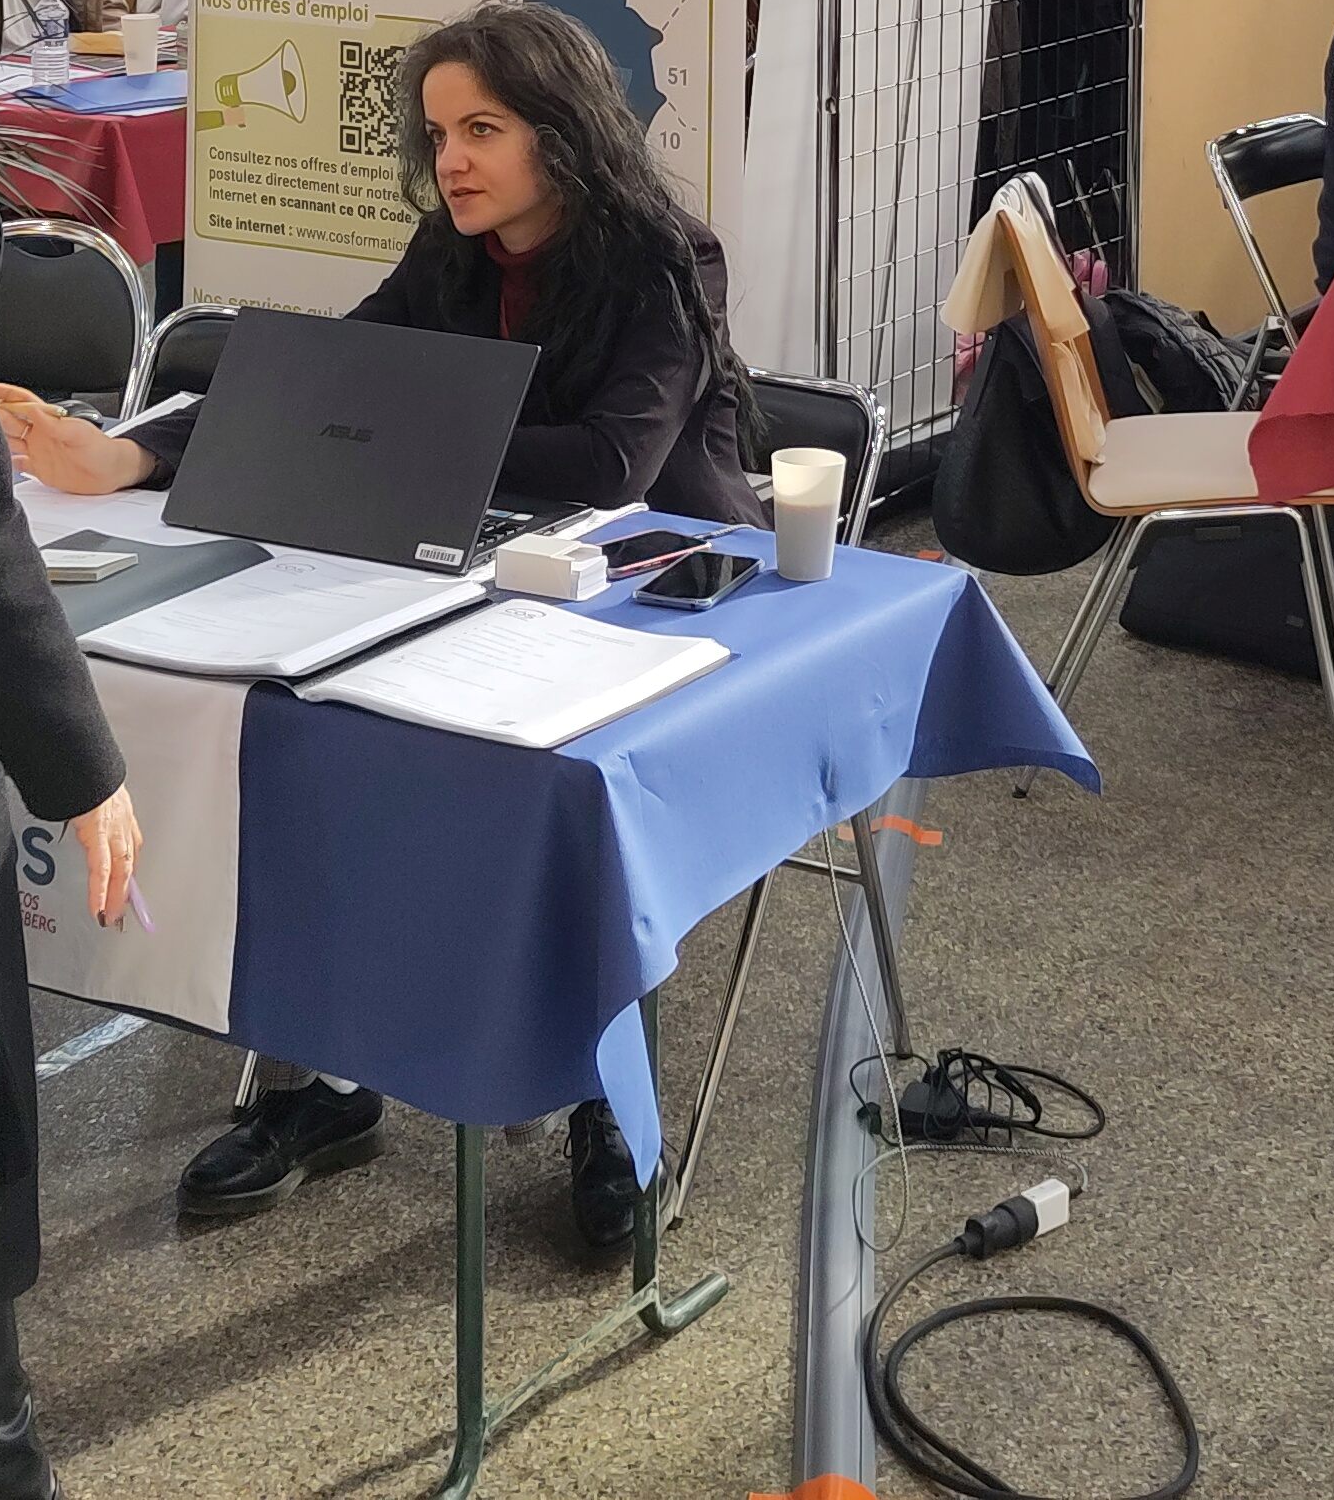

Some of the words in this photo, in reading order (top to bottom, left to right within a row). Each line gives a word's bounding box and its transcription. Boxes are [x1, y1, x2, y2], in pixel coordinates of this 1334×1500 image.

[668, 68, 688, 86] 51
[660, 132, 681, 150] 10
[209, 146, 271, 166] Consultez
[275, 156, 297, 169] nos
[301, 158, 337, 175] offres
[341, 162, 394, 182] d'emploi
[209, 167, 262, 185] postulez
[266, 175, 340, 194] directement
[343, 185, 363, 197] sur
[366, 188, 400, 201] notre
[209, 186, 257, 203] Internet
[260, 194, 276, 206] en
[280, 197, 336, 215] scannant
[339, 204, 354, 217] ce
[357, 206, 376, 220] QR
[379, 208, 416, 225] Code.
[208, 214, 232, 229] Site
[235, 216, 286, 235] internet
[296, 227, 409, 252] www.cosformation
[319, 423, 373, 443] ASUS
